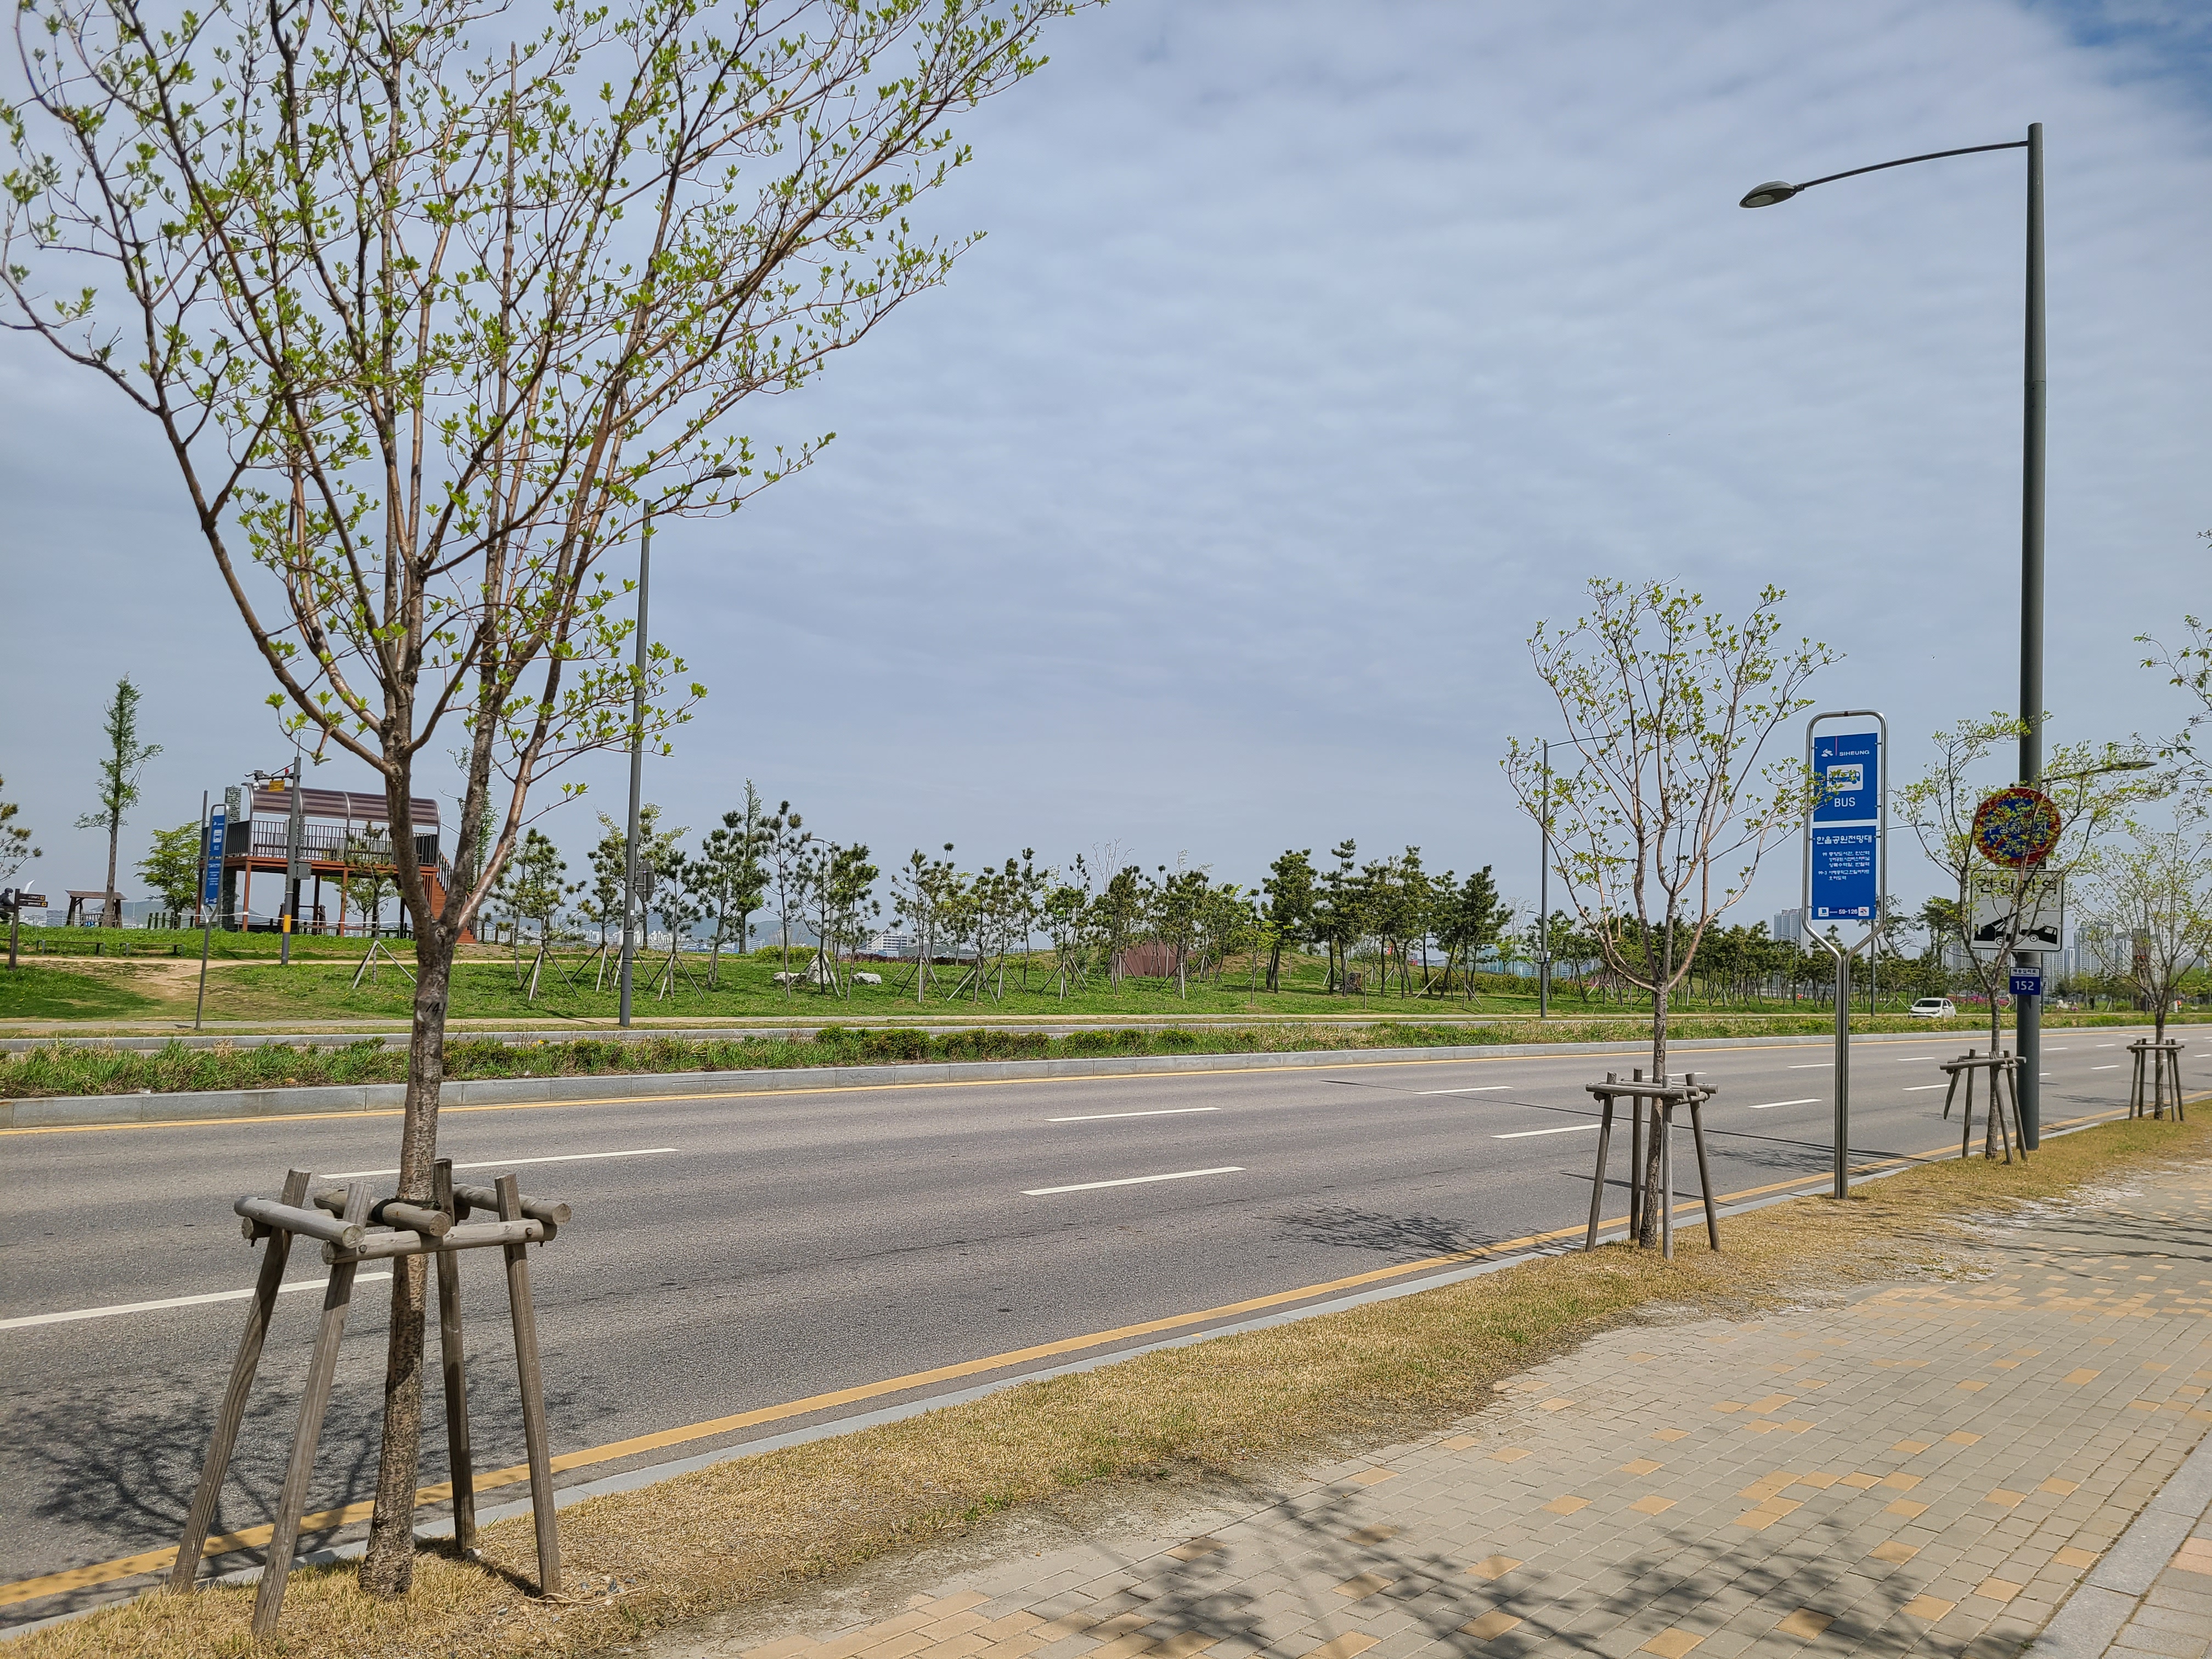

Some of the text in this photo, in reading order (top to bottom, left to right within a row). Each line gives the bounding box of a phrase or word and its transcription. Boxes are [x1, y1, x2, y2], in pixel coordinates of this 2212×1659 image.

[1834, 797, 1855, 808] BUS
[1816, 834, 1872, 844] 한울공원전망대
[2015, 980, 2034, 991] 152
[425, 1002, 445, 1018] 141
